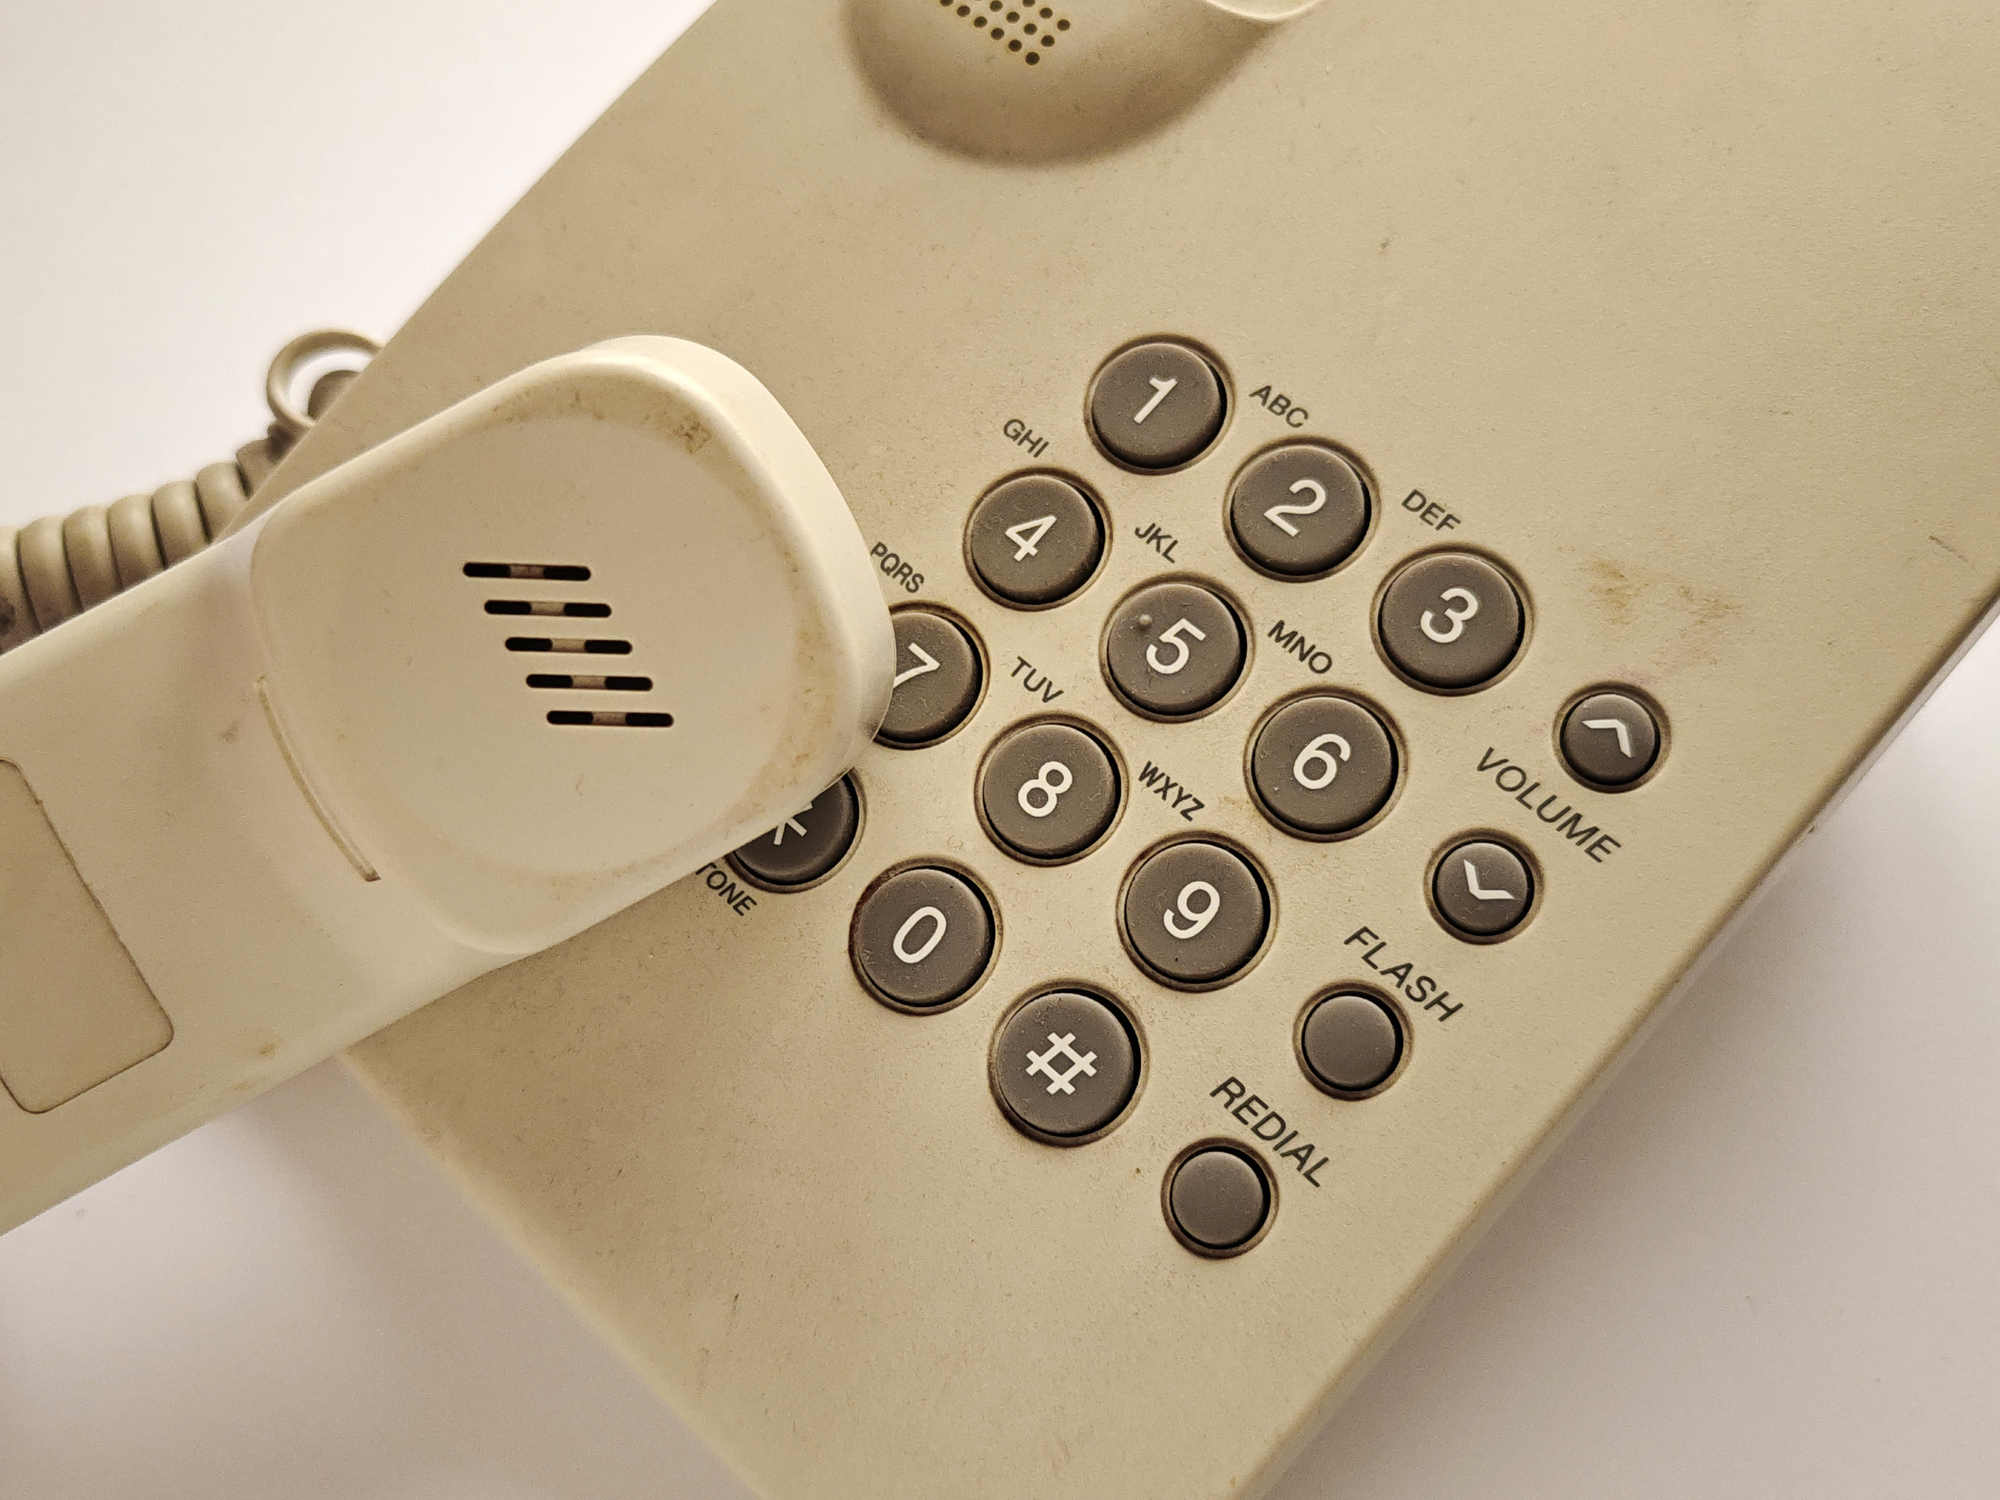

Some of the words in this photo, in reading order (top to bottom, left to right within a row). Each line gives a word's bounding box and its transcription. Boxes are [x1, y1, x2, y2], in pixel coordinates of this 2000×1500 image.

[1134, 377, 1178, 424] 1
[1248, 384, 1309, 429] ABC
[1003, 418, 1050, 459] GHI
[1263, 479, 1326, 537] 2
[1401, 488, 1462, 534] DEF
[1004, 515, 1057, 562] 4
[1134, 522, 1179, 564] JKL
[870, 541, 925, 594] PQRS
[1420, 587, 1479, 643] 3
[893, 642, 941, 689] 7
[1146, 618, 1207, 674] 5
[1267, 619, 1333, 675] MNO
[1010, 655, 1065, 704] TUV
[1017, 760, 1073, 817] 8
[1293, 733, 1351, 790] 6
[1138, 760, 1206, 822] WXYZ
[1476, 747, 1622, 862] VOLUME
[893, 906, 947, 964] 0
[1163, 880, 1220, 939] 9
[1344, 926, 1463, 1022] FLASH
[1025, 1032, 1098, 1095] #
[1209, 1076, 1336, 1188] REDIAL
